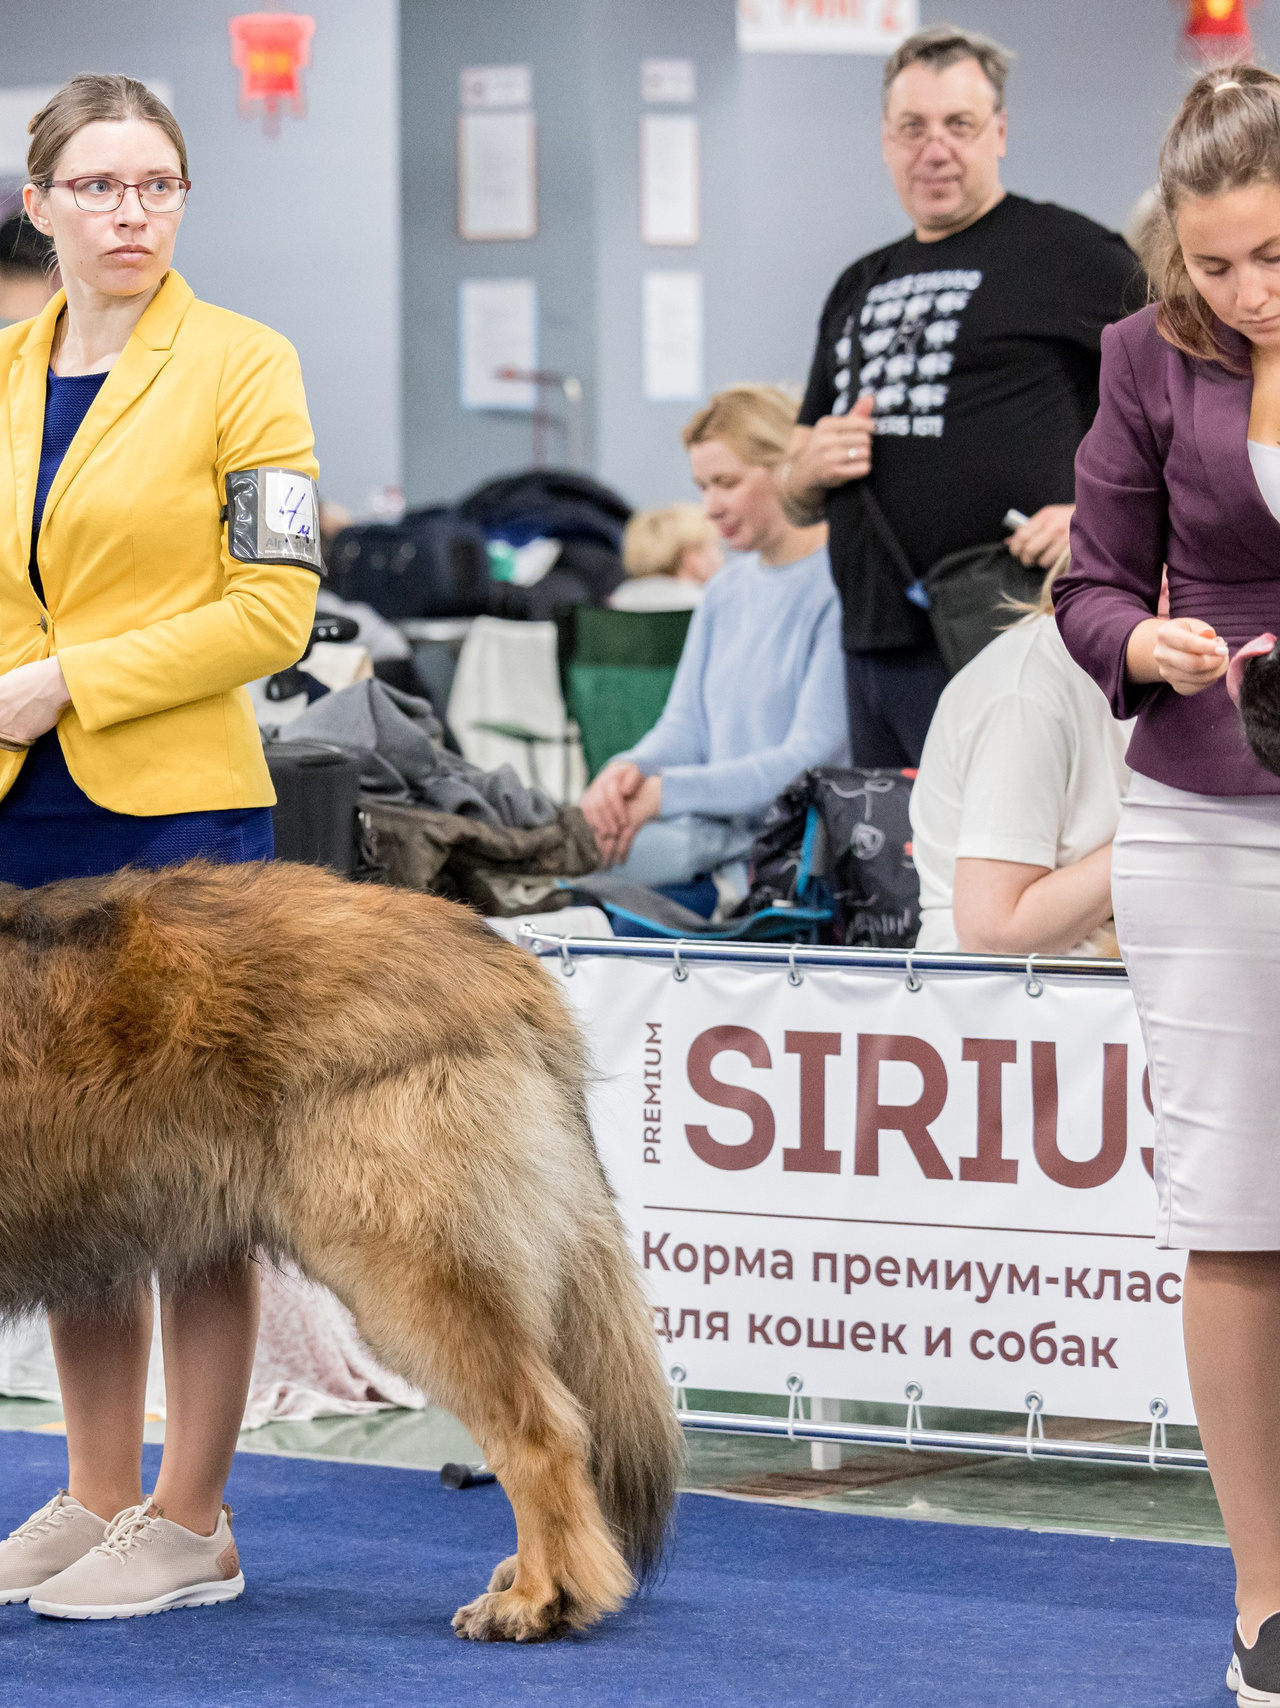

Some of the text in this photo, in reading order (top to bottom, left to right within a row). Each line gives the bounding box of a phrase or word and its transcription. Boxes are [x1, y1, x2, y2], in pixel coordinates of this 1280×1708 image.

[643, 1022, 662, 1164] PREMIUM
[642, 1230, 794, 1284] Корма
[747, 1311, 908, 1356] кошек
[924, 1326, 952, 1358] и
[969, 1320, 1120, 1370] собак
